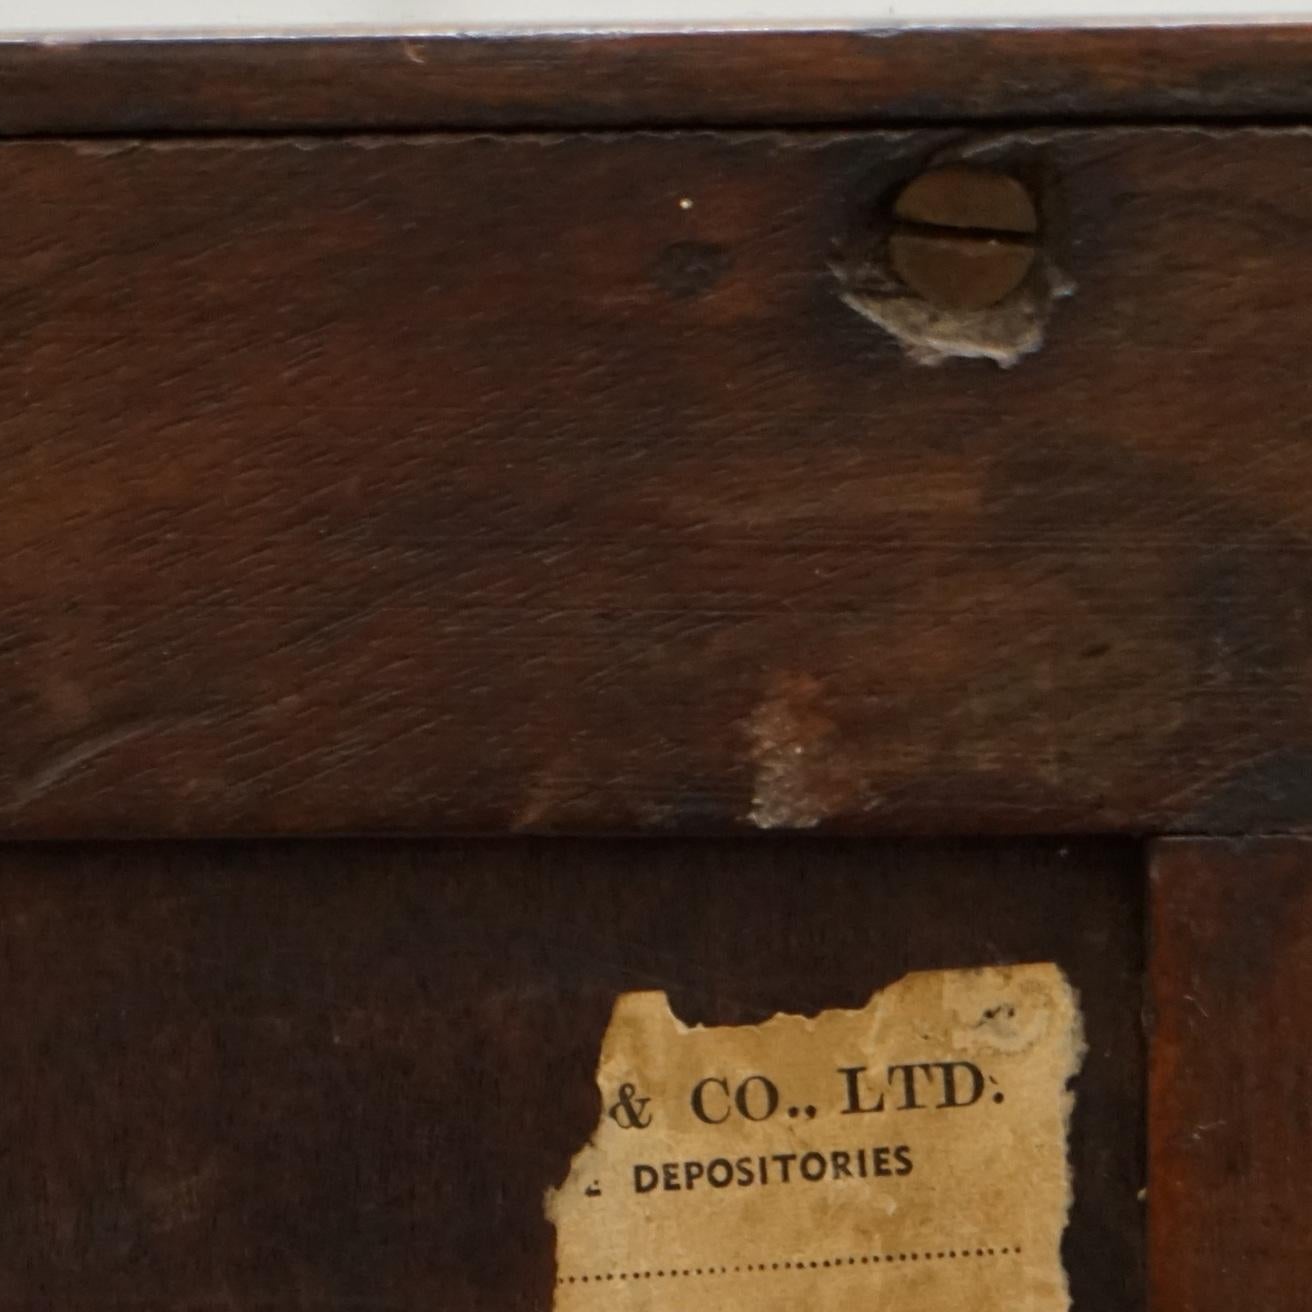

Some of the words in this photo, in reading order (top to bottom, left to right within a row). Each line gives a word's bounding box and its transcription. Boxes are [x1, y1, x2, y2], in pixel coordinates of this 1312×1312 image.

[608, 1082, 652, 1129] &
[837, 1061, 1005, 1115] LTD.
[634, 1145, 913, 1194] DEPOSITORIES
